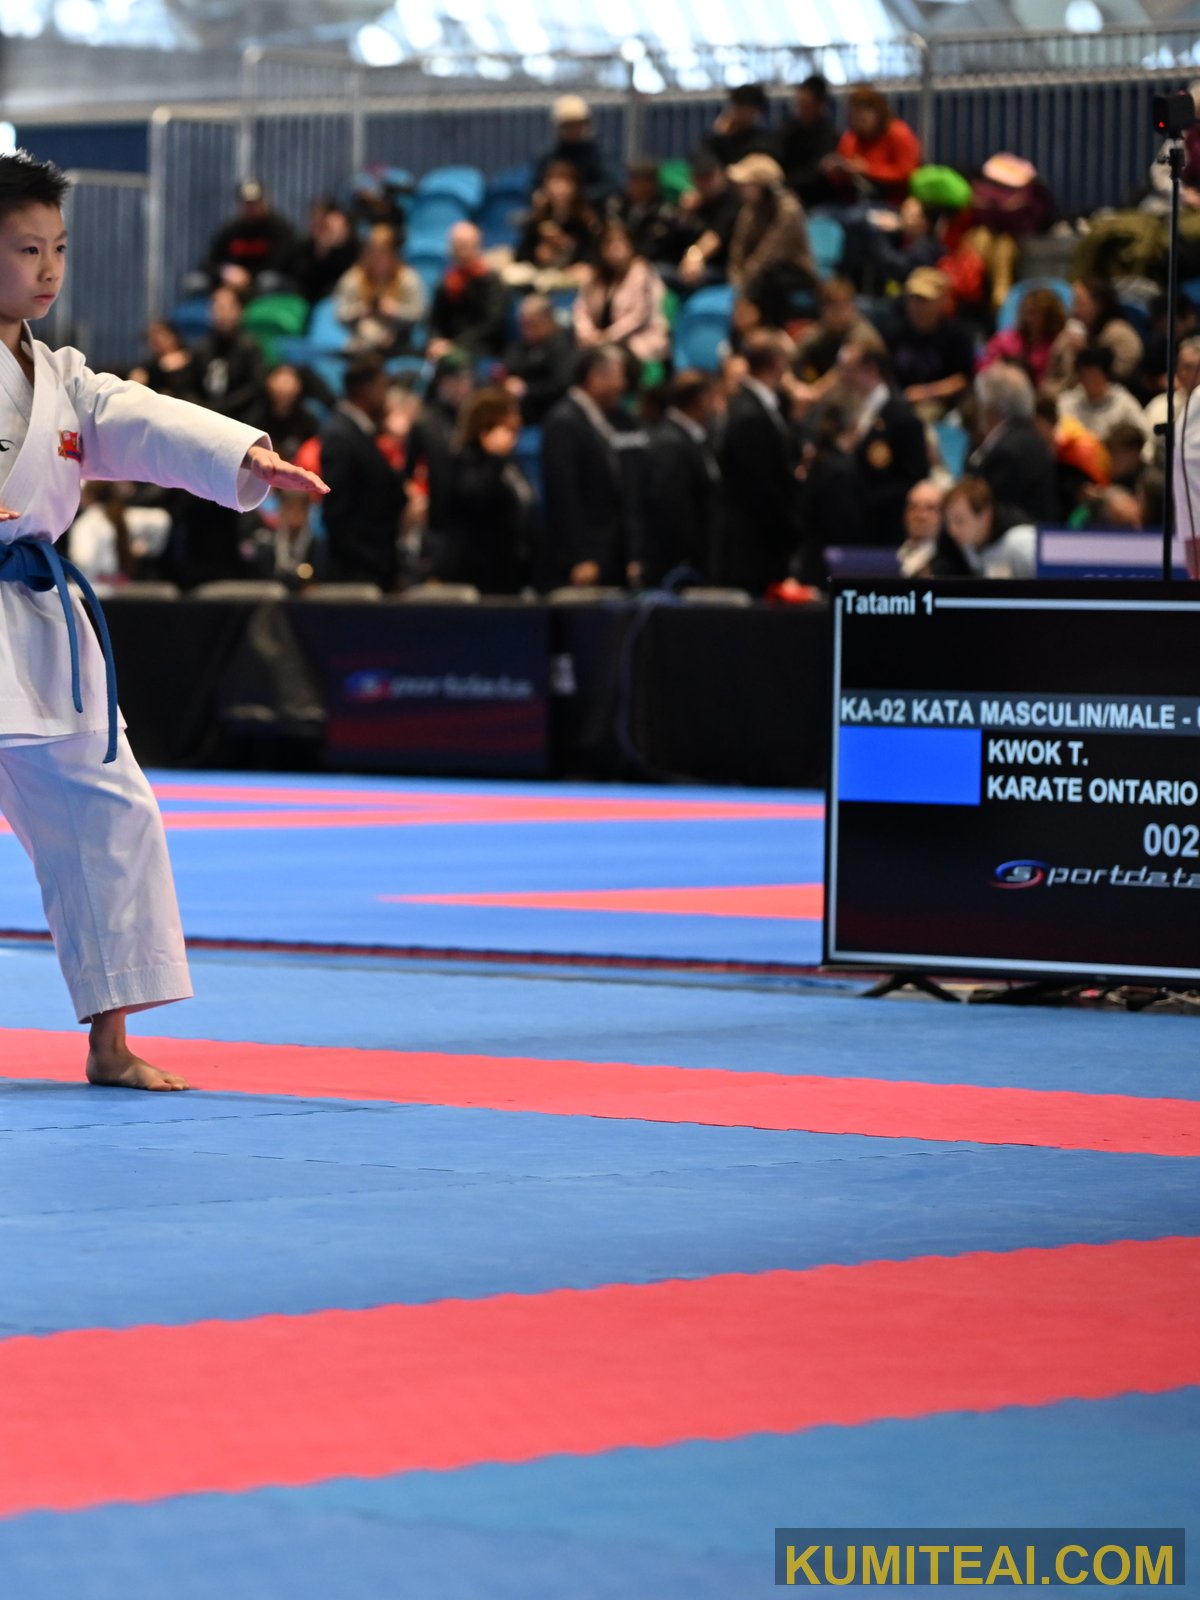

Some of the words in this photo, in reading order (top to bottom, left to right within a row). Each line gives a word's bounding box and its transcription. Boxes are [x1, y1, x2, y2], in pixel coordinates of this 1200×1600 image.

[842, 590, 915, 614] Tatami
[922, 590, 933, 615] 1
[840, 697, 906, 722] KA-02
[911, 699, 974, 724] KATA
[979, 701, 1175, 729] MASCULIN/MALE
[987, 739, 1062, 766] KWOK
[1067, 741, 1089, 766] T.
[987, 775, 1083, 802] KARATE
[1088, 778, 1198, 806] ONTARIO
[1143, 823, 1200, 858] 002
